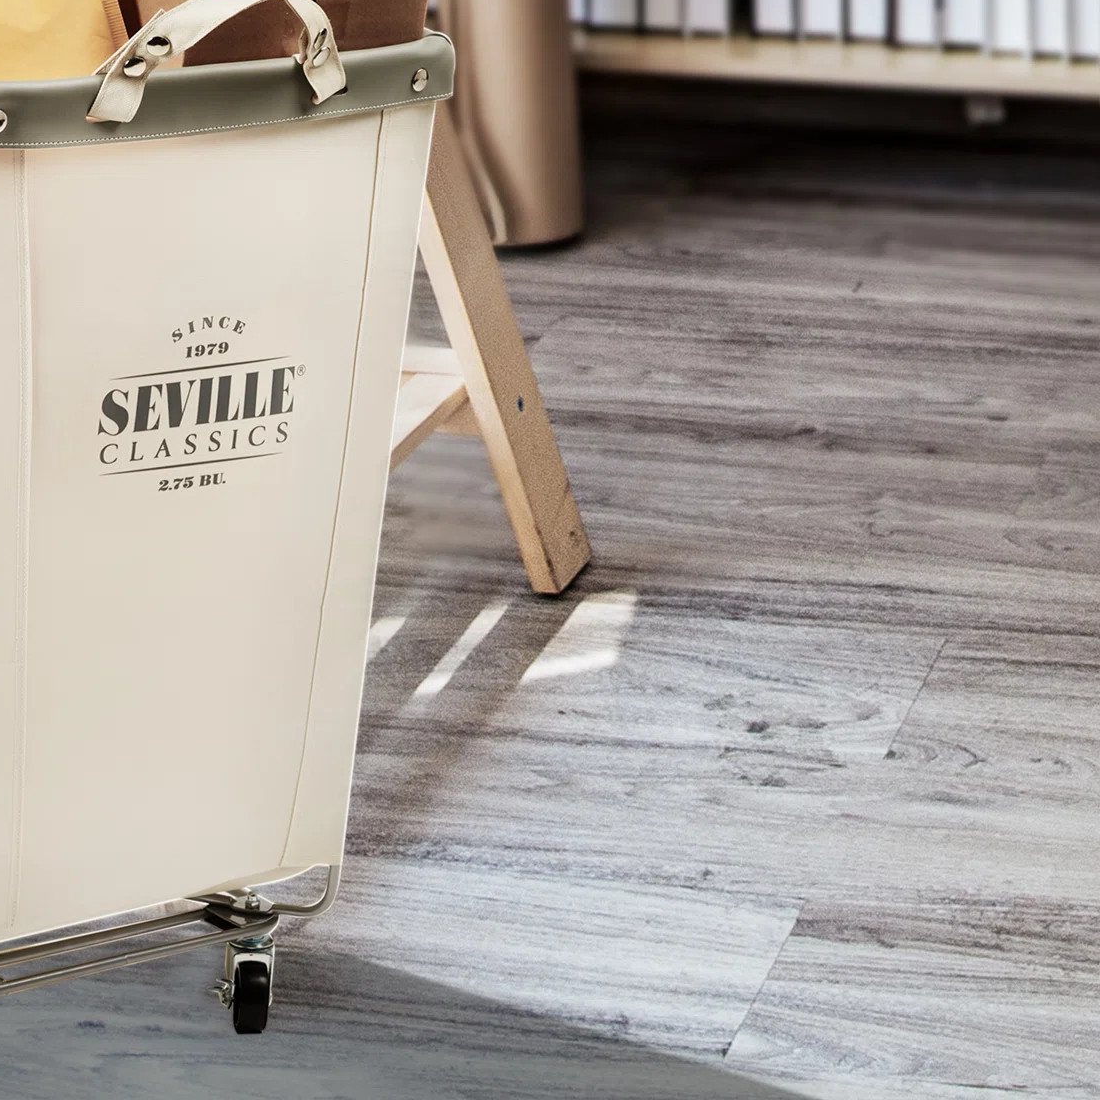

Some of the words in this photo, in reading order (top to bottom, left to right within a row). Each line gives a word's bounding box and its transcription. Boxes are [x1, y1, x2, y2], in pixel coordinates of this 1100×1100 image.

[171, 315, 247, 343] SINCE
[185, 341, 230, 359] 1979
[99, 421, 289, 465] CLASSICS
[158, 476, 194, 492] 2.75
[199, 473, 226, 488] BU.
